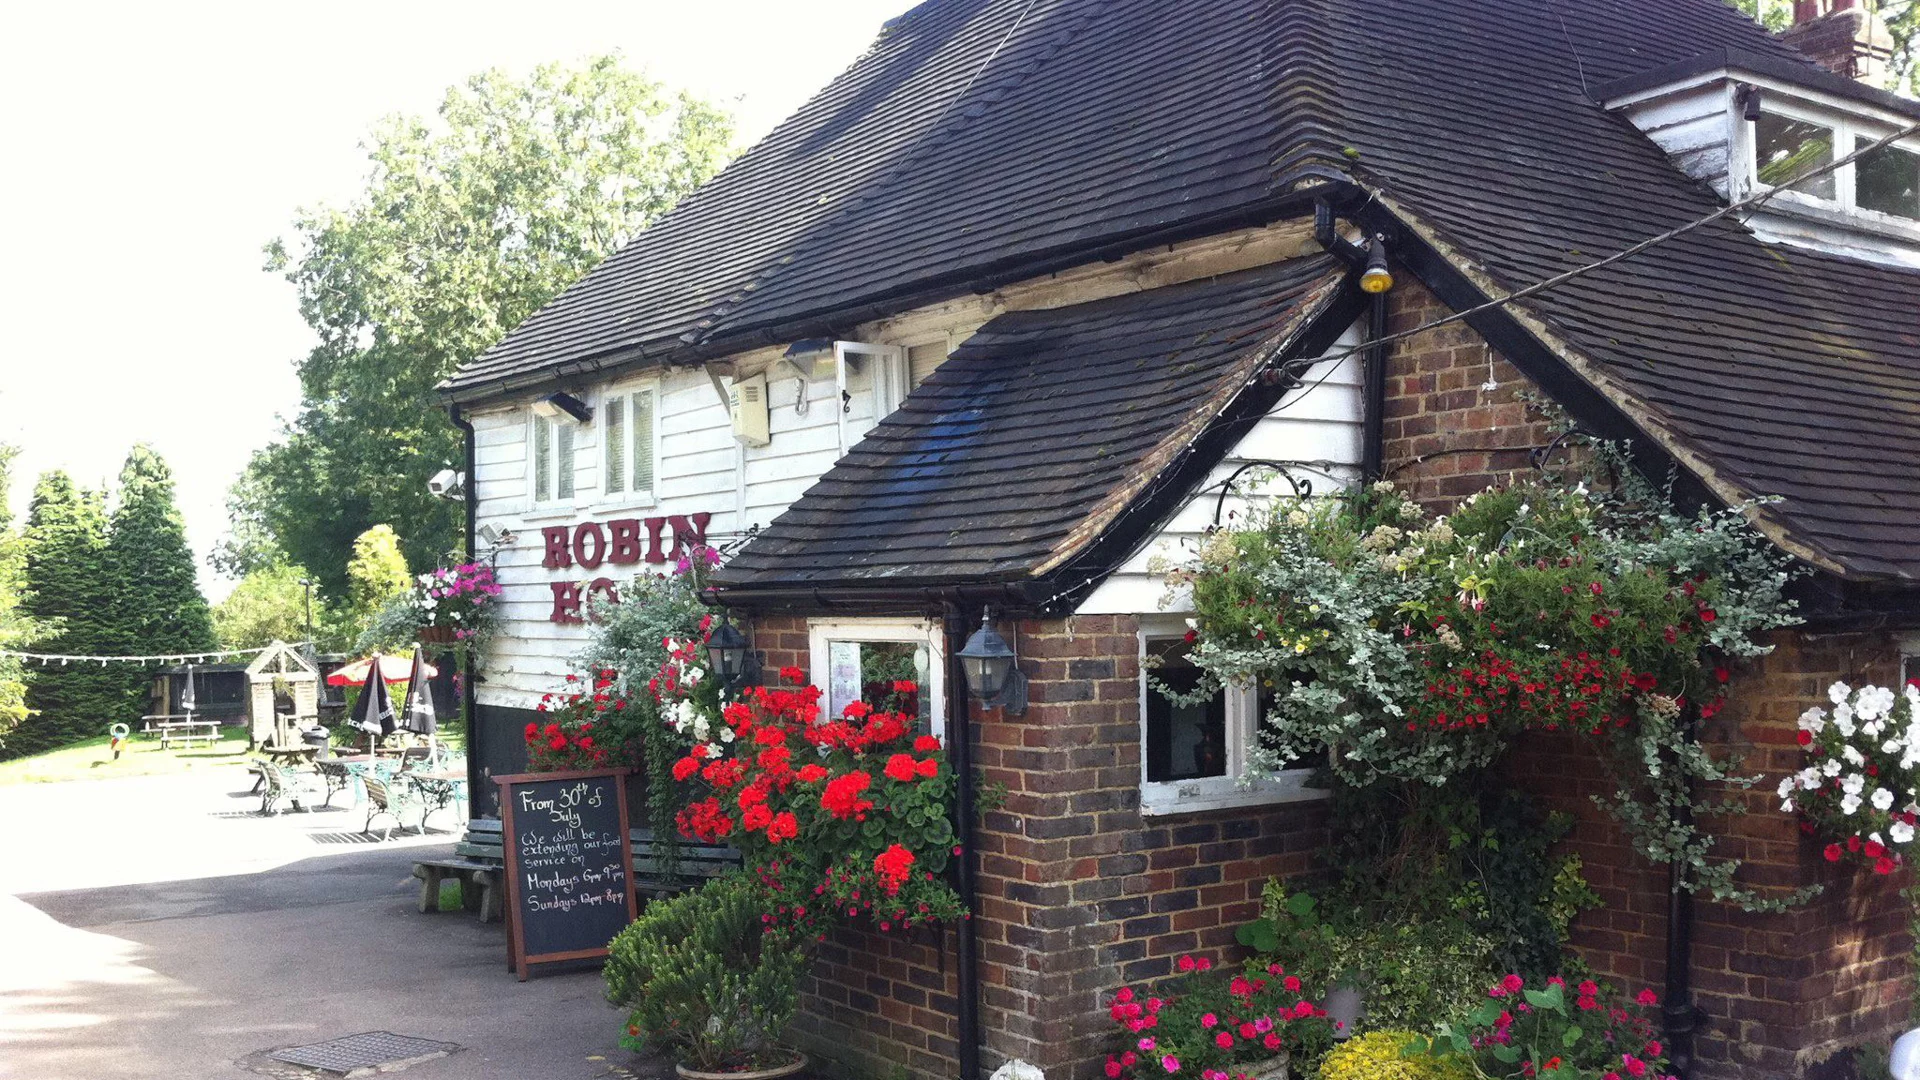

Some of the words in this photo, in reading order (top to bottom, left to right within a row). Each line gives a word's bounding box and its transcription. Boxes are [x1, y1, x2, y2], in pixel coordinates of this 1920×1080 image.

[541, 512, 712, 570] ROBIN
[519, 790, 554, 812] From
[588, 786, 603, 808] of
[548, 807, 581, 829] July
[521, 830, 545, 846] We
[552, 827, 576, 843] will
[580, 827, 596, 840] be
[522, 842, 579, 857] extending
[583, 840, 601, 850] our
[524, 856, 566, 869] service
[571, 855, 585, 867] on
[527, 871, 580, 894] Mondays
[527, 894, 578, 913] Sundays
